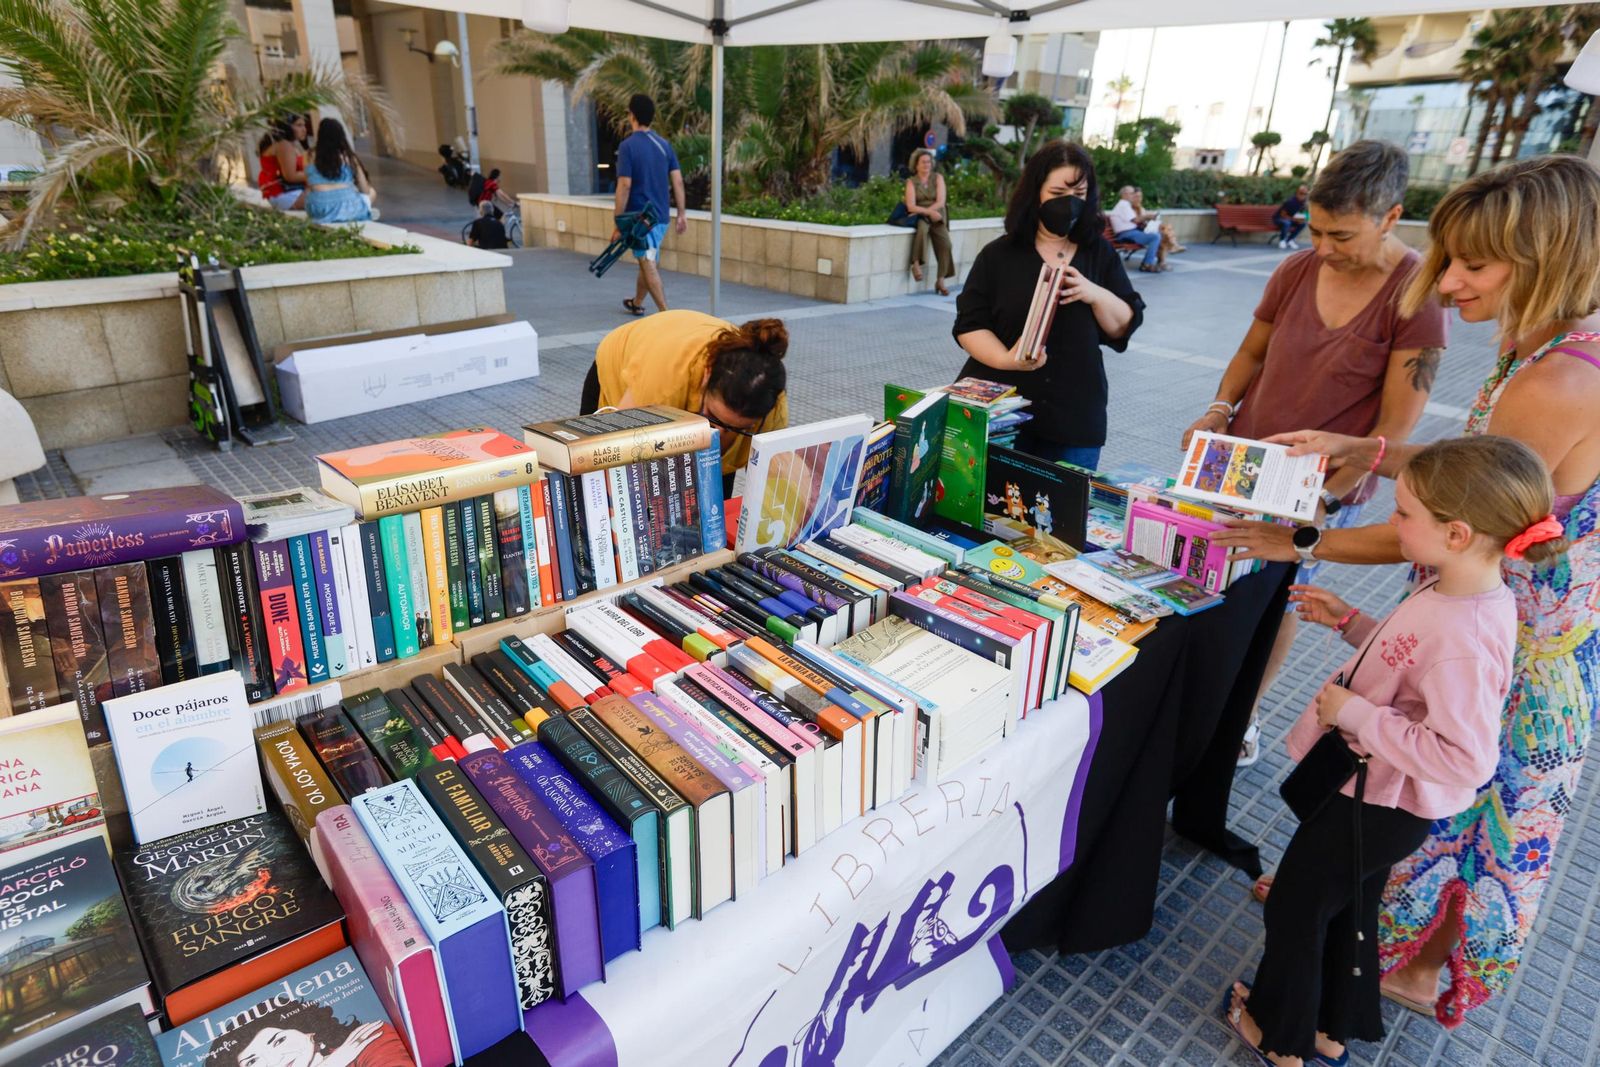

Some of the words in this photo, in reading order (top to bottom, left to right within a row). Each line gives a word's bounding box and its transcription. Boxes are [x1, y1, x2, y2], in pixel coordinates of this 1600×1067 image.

[593, 447, 611, 457] ALAS
[593, 453, 621, 466] SANGRE
[667, 457, 675, 471] JOËL
[683, 453, 691, 466] JOËL
[615, 468, 624, 496] JAVIER
[631, 464, 640, 493] JAVIER
[650, 462, 658, 476] JOËL
[685, 467, 693, 487] DICKER
[376, 475, 445, 500] ELÍSABET
[543, 484, 551, 505] WOOLF
[652, 477, 660, 497] DICKER
[669, 472, 677, 493] DICKER
[375, 486, 449, 512] BENAVENT
[522, 488, 530, 513] EMPEZAR
[446, 509, 456, 534] BRANDON
[464, 506, 473, 533] BRANDON
[481, 502, 491, 528] BRANDON
[619, 497, 628, 534] CASTILLO
[635, 494, 645, 531] CASTILLO
[483, 528, 494, 558] SANDERSON
[526, 519, 534, 541] VOLVER
[44, 529, 145, 565] Powerless
[296, 539, 306, 568] BARCELÓ
[449, 534, 459, 567] SANDERSON
[465, 533, 476, 563] SANDERSON
[528, 543, 537, 565] HOOVER
[231, 552, 240, 576] REYES
[258, 550, 268, 582] ANDERSON
[273, 550, 281, 576] HERBERT
[318, 549, 327, 574] BARCELÓ
[779, 555, 808, 572] ROMA
[809, 568, 833, 584] SOY
[830, 578, 848, 590] YO
[197, 562, 207, 588] MIKEL
[530, 565, 538, 589] COLLEEN
[62, 582, 78, 616] BRANDON
[115, 576, 130, 611] BRANDON
[162, 565, 171, 596] CRISTINA
[167, 596, 177, 624] MORATÓ
[235, 576, 247, 613] MONFORTE
[302, 582, 310, 597] RITA
[323, 583, 333, 610] AMORES
[201, 588, 214, 630] SANTIAGO
[268, 593, 290, 624] DUNE
[305, 598, 314, 619] SANTA
[327, 610, 336, 626] QUE
[397, 583, 411, 631] AUTOAMOR
[10, 590, 28, 625] BRANDON
[19, 625, 37, 668] SANDERSON
[120, 611, 137, 649] SANDERSON
[308, 619, 315, 631] EN
[599, 605, 608, 614] LA
[606, 608, 620, 622] HORA
[618, 618, 630, 629] DEL
[628, 624, 645, 638] LOBO
[934, 607, 947, 616] THE
[978, 625, 996, 637] TOUR
[68, 616, 87, 658] SANDERSON
[244, 630, 255, 665] VIOLINISTA
[309, 631, 320, 659] MUERTE
[777, 654, 785, 662] LA
[784, 658, 806, 675] PLANTA
[805, 669, 822, 686] BAJA
[79, 688, 89, 721] ASCENSIÓN
[88, 690, 96, 706] POZO
[696, 671, 722, 692] AUTÉNTICAS
[720, 689, 751, 712] IMPOSTORAS
[132, 706, 170, 721] Doce
[175, 695, 229, 715] pájaros
[135, 723, 153, 734] en
[158, 718, 171, 728] el
[175, 707, 231, 724] alambre
[259, 726, 290, 737] SANTIAGO
[747, 732, 759, 742] DE
[757, 739, 779, 756] DUNE
[0, 758, 24, 770] NA
[390, 743, 399, 753] DE
[395, 752, 412, 768] ROMA
[399, 739, 420, 766] TRAICIÓN
[519, 755, 536, 770] DOOM
[529, 753, 544, 765] ERIN
[619, 756, 639, 772] MARIDOS
[275, 740, 300, 769] ROMA
[293, 768, 317, 789] SOY
[309, 788, 326, 805] YO
[637, 770, 651, 786] SIETE
[639, 765, 656, 782] EVELYN
[671, 763, 693, 781] ALAS
[677, 755, 706, 779] SANGRE
[435, 769, 454, 785] EL
[446, 783, 492, 833] FAMILIAR
[488, 775, 536, 822] Powerless
[547, 788, 576, 817] LÁGRIMAS
[550, 774, 588, 810] FABRICANTE
[183, 810, 204, 819] Miguel
[206, 804, 224, 813] Ángel
[332, 814, 350, 832] IRA
[391, 814, 417, 828] CASA
[395, 824, 428, 841] CIELO
[396, 832, 442, 855] ALIENTO
[133, 834, 219, 866] GEORGE
[142, 827, 267, 882] MARTIN
[487, 843, 508, 866] BARDUGO
[499, 843, 515, 860] LEIGH
[0, 856, 88, 896] ARCELÓ
[777, 776, 1010, 976] LIBRERIA
[0, 878, 65, 909] SOGA
[2, 903, 27, 918] DE
[171, 895, 276, 945] FUEGO
[285, 889, 296, 901] Y
[380, 895, 402, 920] HUANG
[182, 900, 301, 958] SANGRE
[394, 917, 406, 931] ANA
[279, 1005, 301, 1021] Ana
[301, 991, 333, 1011] Moreno
[334, 976, 361, 993] Durán
[323, 994, 341, 1008] Ana
[341, 984, 364, 999] Jarén
[172, 961, 356, 1060] Almudena
[197, 1038, 239, 1061] biografía
